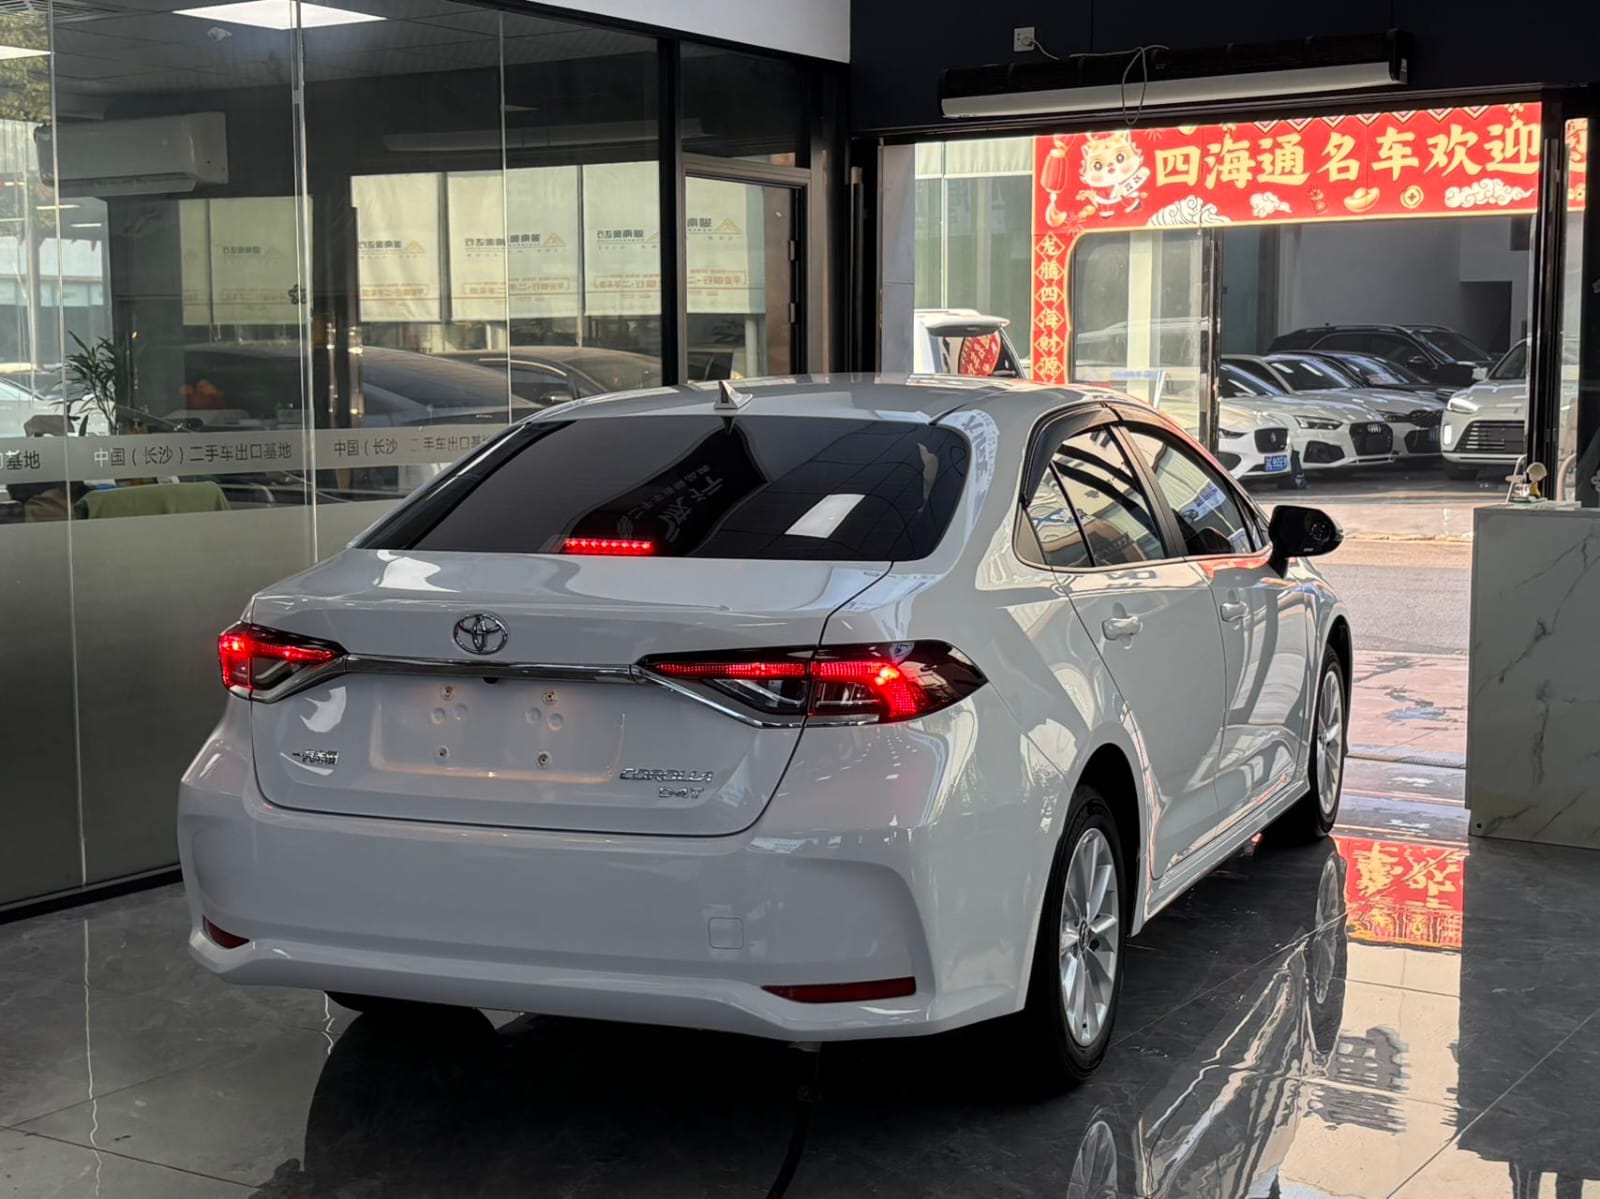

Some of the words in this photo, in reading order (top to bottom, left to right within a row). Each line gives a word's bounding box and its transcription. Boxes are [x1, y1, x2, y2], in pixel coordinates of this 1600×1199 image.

[1154, 119, 1540, 189] 四海通名车欢迎
[0, 450, 41, 470] 基地
[619, 767, 714, 783] COROLLA
